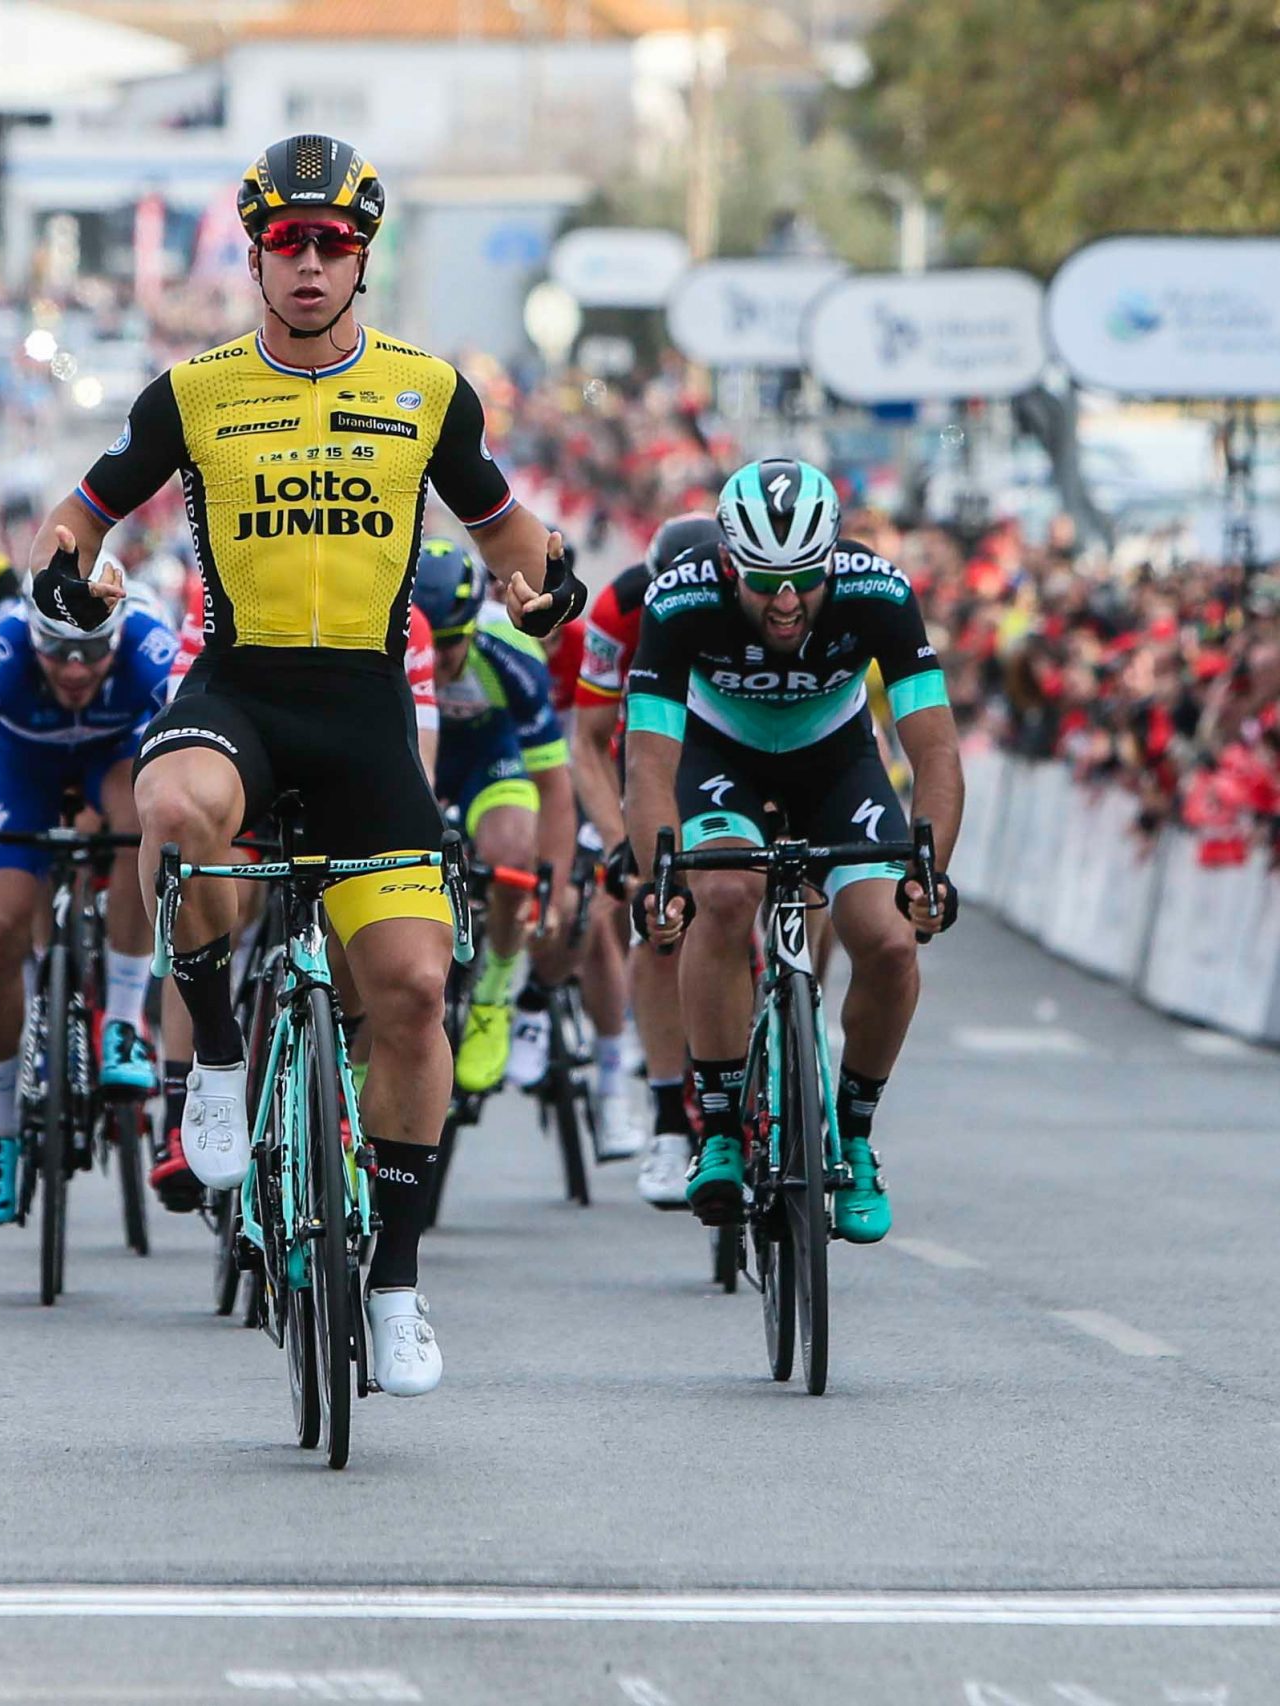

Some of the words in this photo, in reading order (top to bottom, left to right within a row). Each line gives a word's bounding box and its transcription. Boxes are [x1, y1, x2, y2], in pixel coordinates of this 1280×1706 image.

[290, 192, 326, 200] LAZER
[189, 347, 248, 365] Lotto.
[216, 417, 301, 437] Bianchi
[338, 413, 413, 437] brandloyalty
[326, 446, 343, 457] 15
[351, 445, 375, 458] 45
[254, 470, 380, 505] Lotto.
[233, 507, 395, 541] JUMBO
[833, 551, 912, 588] BORA
[644, 559, 719, 606] BORA
[710, 669, 854, 691] BORA
[376, 1166, 419, 1185] otto.
